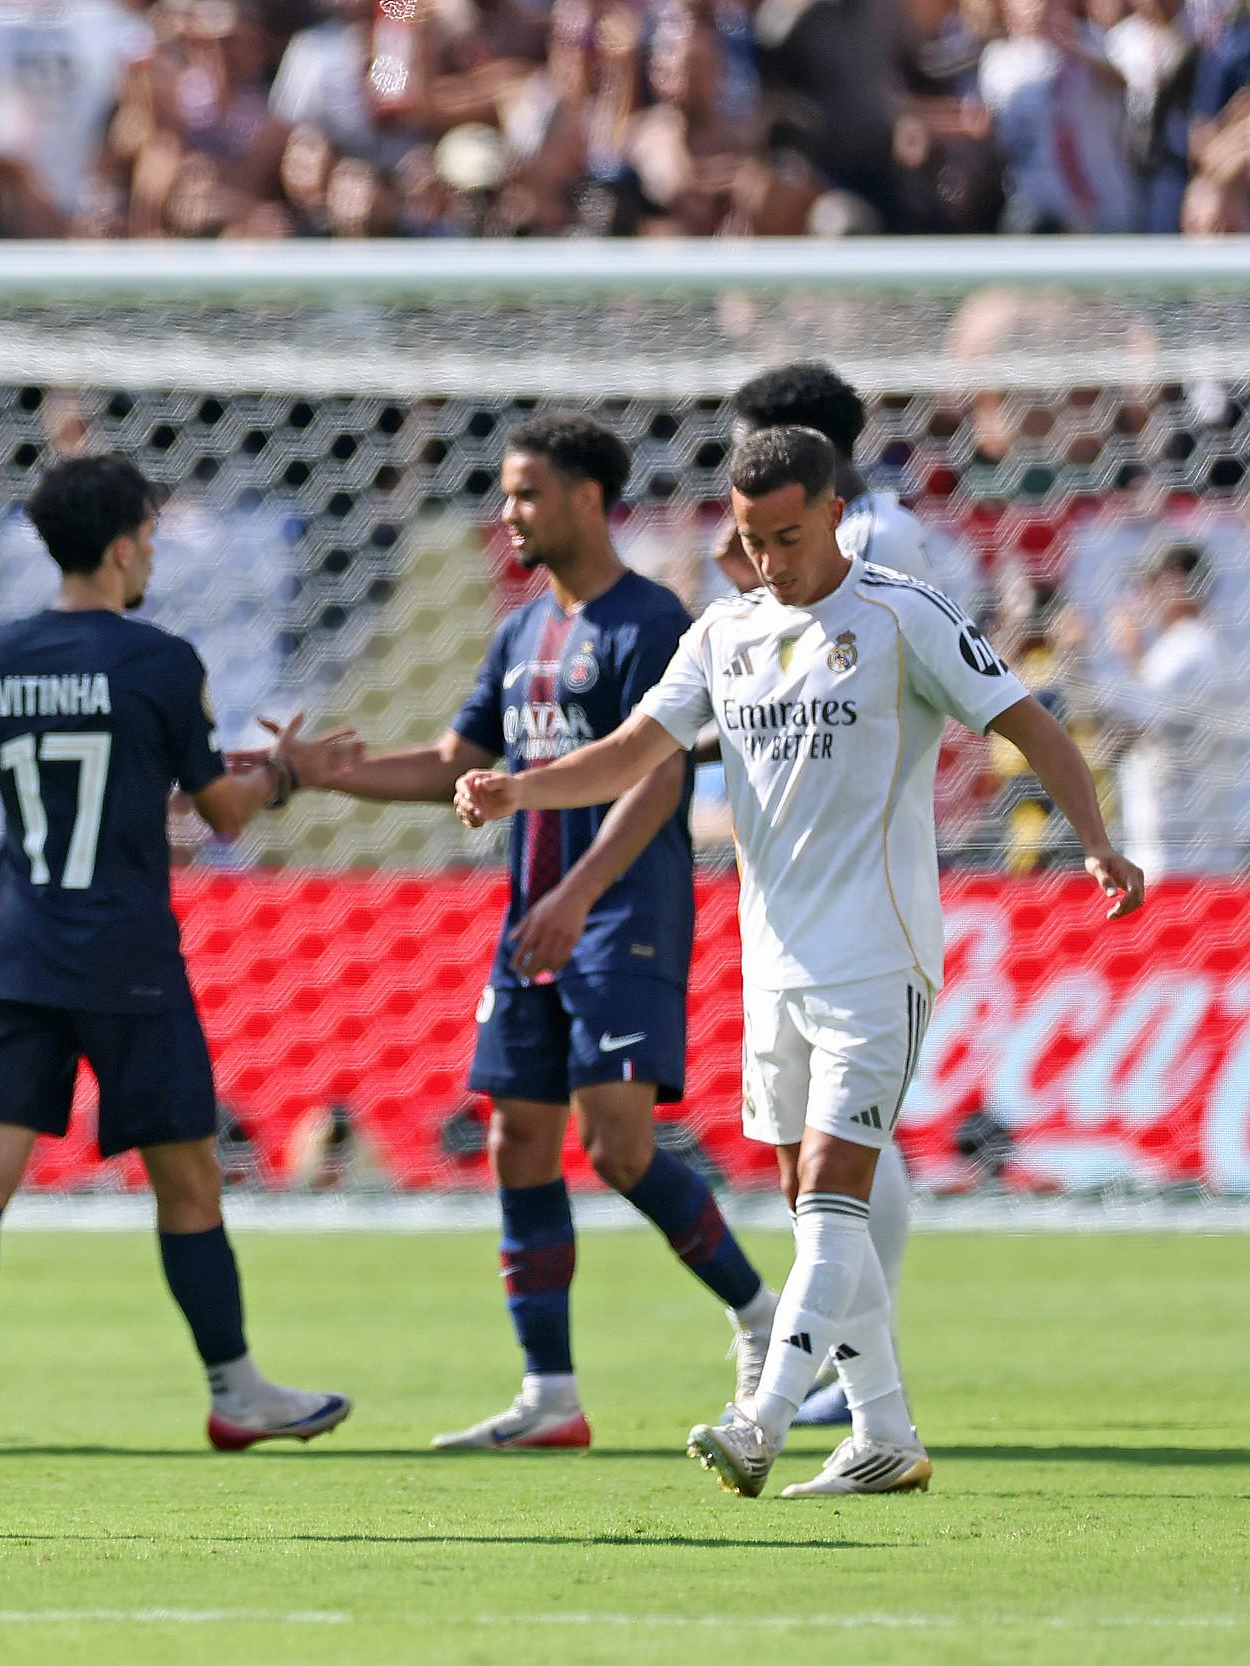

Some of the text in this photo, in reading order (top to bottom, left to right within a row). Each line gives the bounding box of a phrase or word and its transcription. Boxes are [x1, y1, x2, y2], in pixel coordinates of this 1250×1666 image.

[503, 701, 594, 743] QATAR
[723, 696, 858, 730] Emirates
[771, 733, 834, 760] BETER
[0, 731, 112, 889] 17
